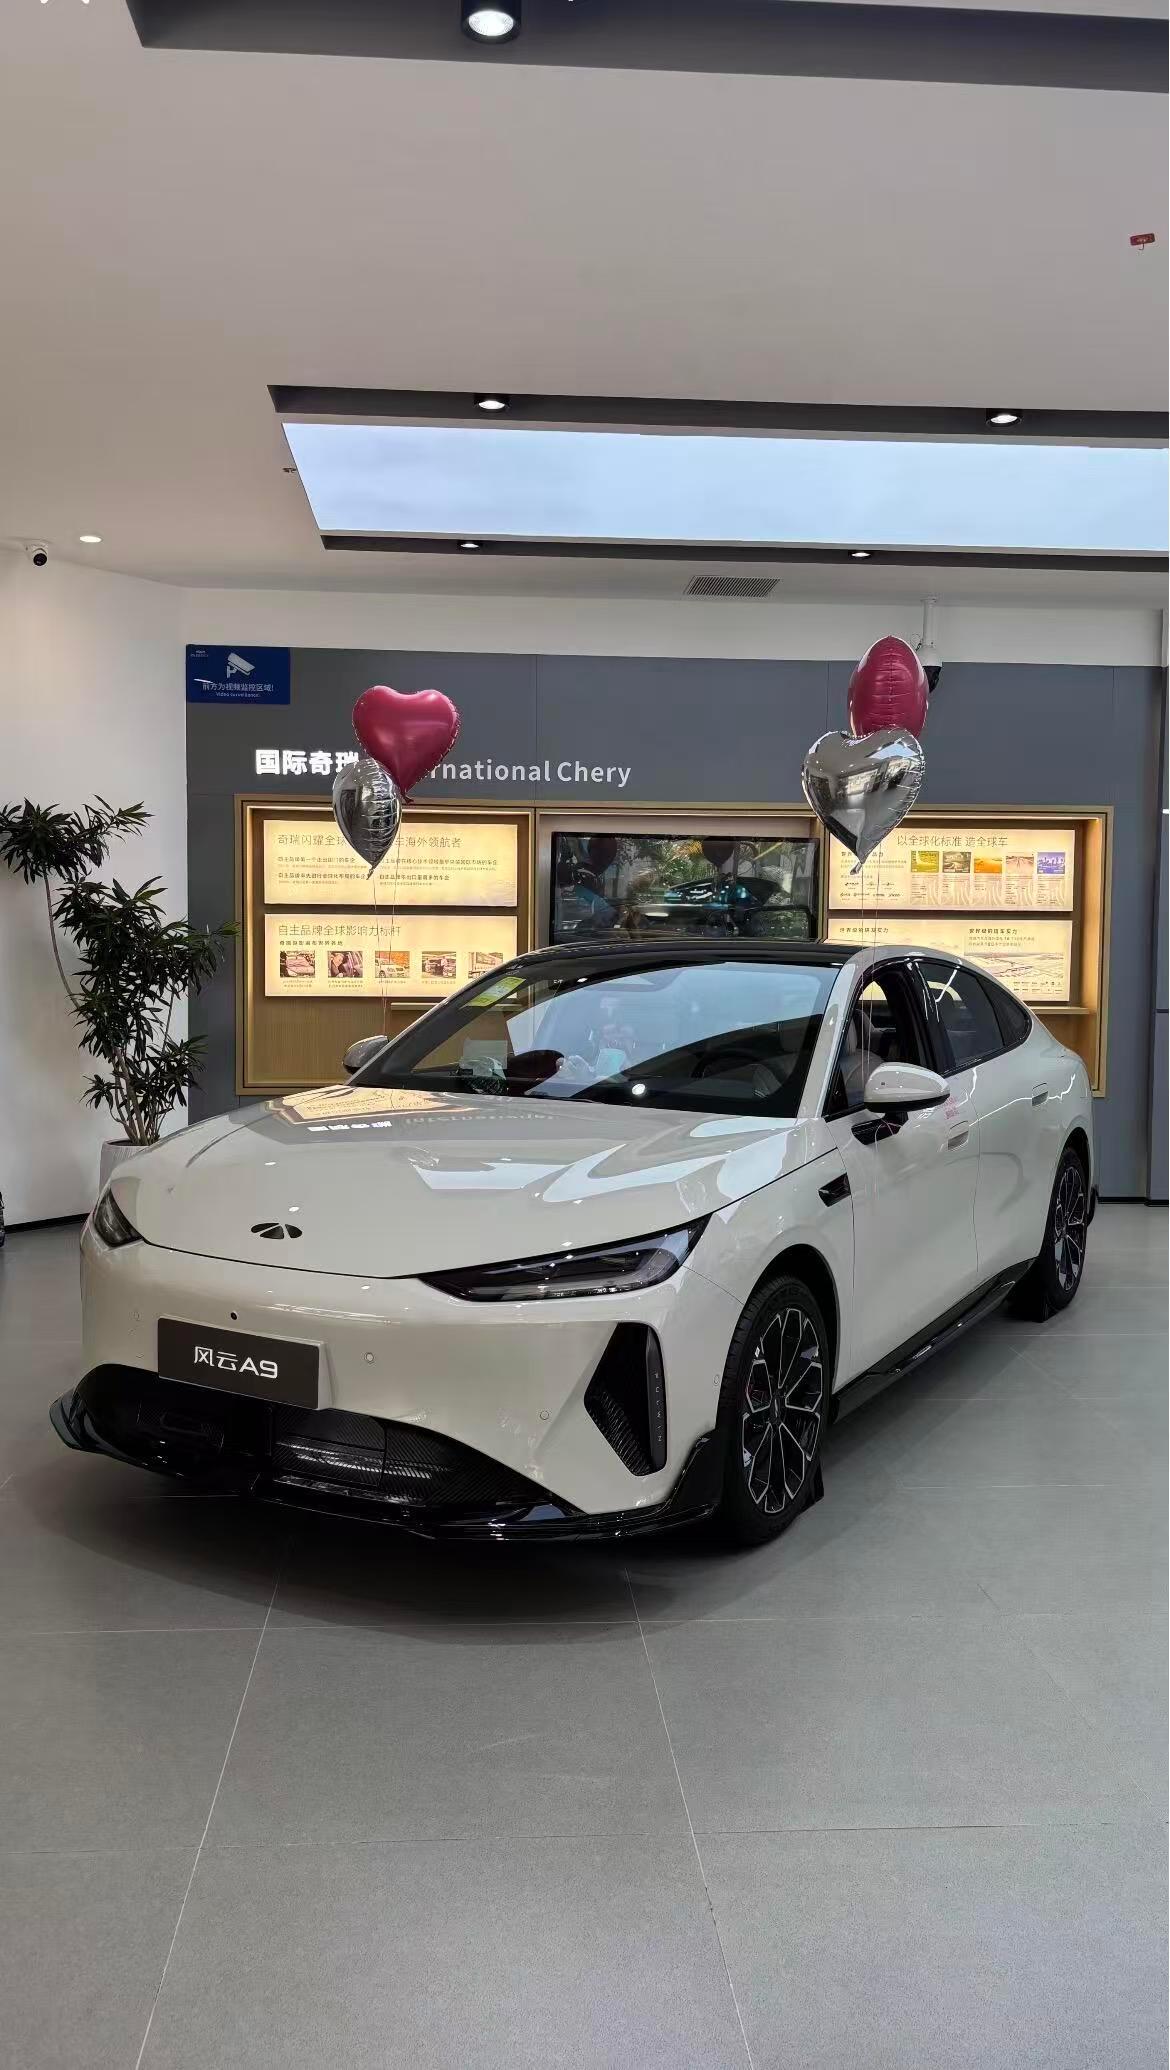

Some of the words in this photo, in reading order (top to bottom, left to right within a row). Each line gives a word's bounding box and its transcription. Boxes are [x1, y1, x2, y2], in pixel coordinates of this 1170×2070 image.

[430, 758, 551, 781] rnational
[557, 760, 632, 788] Chery
[897, 835, 962, 847] 以全球化标准
[965, 836, 1008, 847] 造全球车
[278, 924, 402, 937] 自主品牌全球影响力标杆
[194, 1345, 279, 1379] 风云A9
